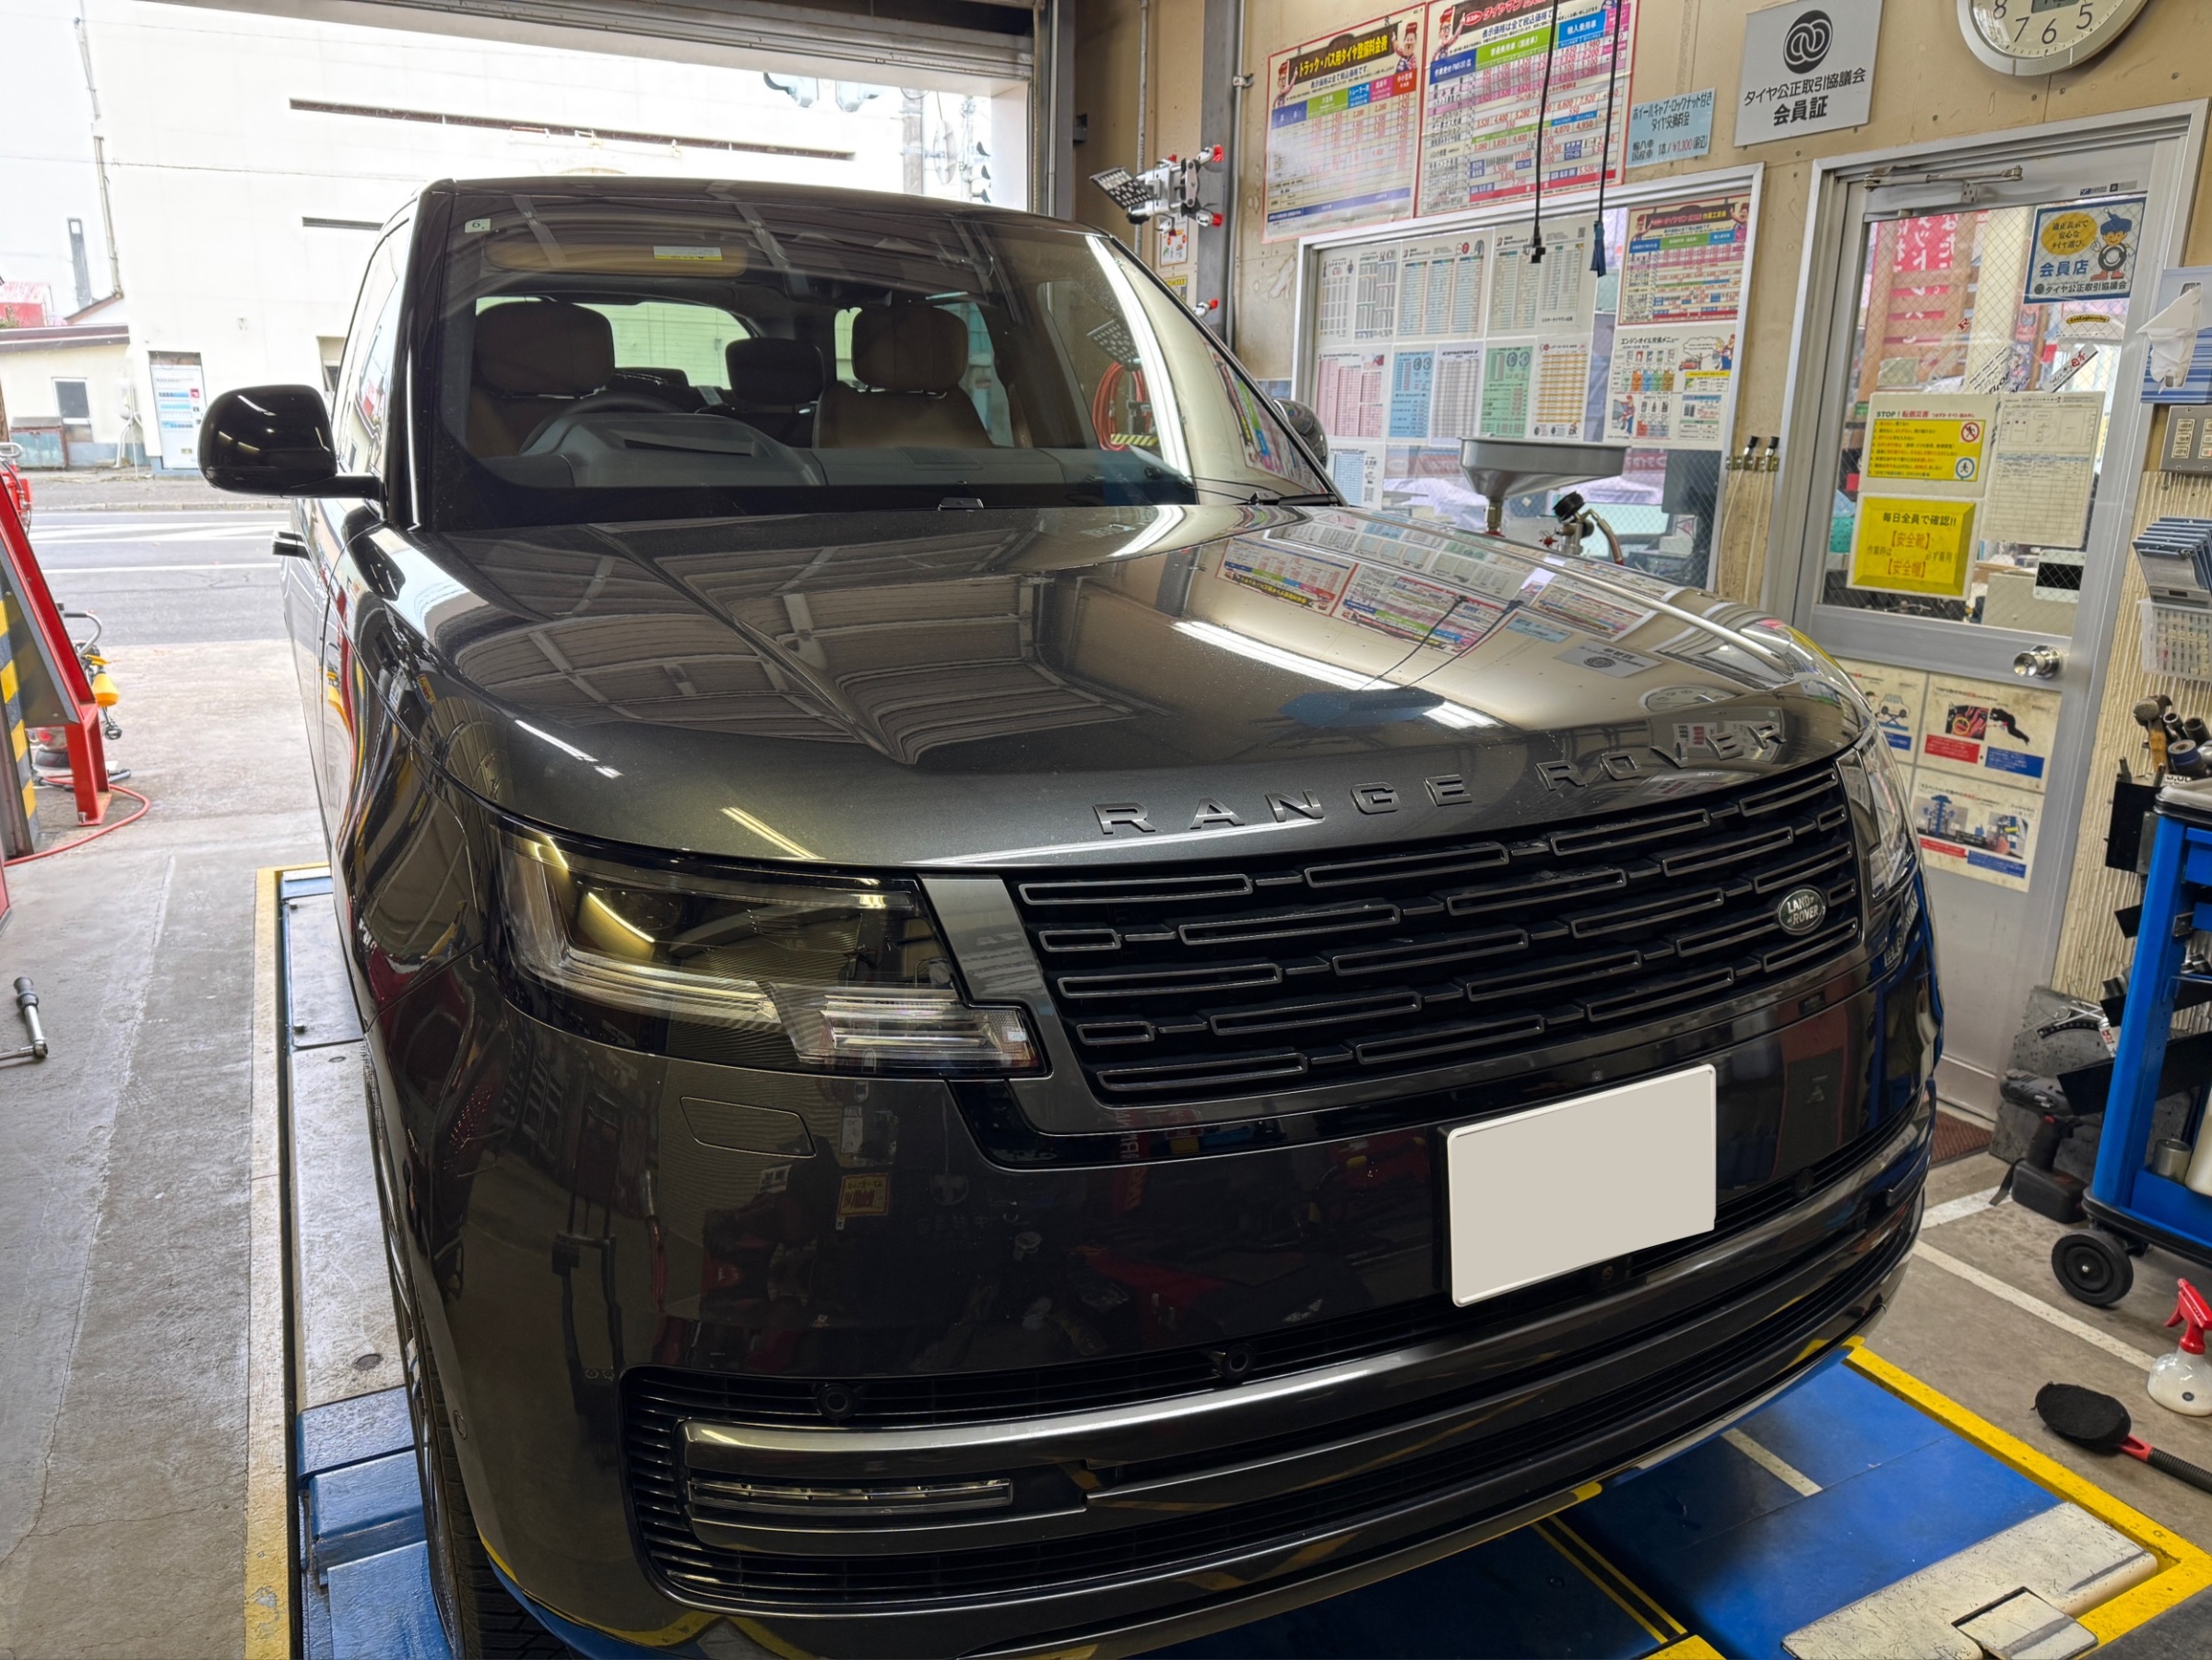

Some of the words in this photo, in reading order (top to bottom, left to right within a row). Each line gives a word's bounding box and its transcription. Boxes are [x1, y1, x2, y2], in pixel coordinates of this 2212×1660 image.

[1993, 0, 2007, 19] 8
[2076, 3, 2093, 30] 5
[1482, 8, 1556, 39] 表示価格は全て税込価格で
[2016, 17, 2030, 42] 7
[2041, 18, 2057, 44] 6
[1745, 67, 1866, 106] タイヤ公正取引協議会
[1773, 95, 1829, 126] 会員証
[2040, 259, 2088, 277] 会員店
[2045, 281, 2126, 293] タイヤ公正取引協議会
[1093, 773, 1473, 835] RANGE
[1536, 722, 1787, 790] ROVER
[1787, 895, 1810, 913] LAND
[1792, 904, 1819, 925] ROVER
